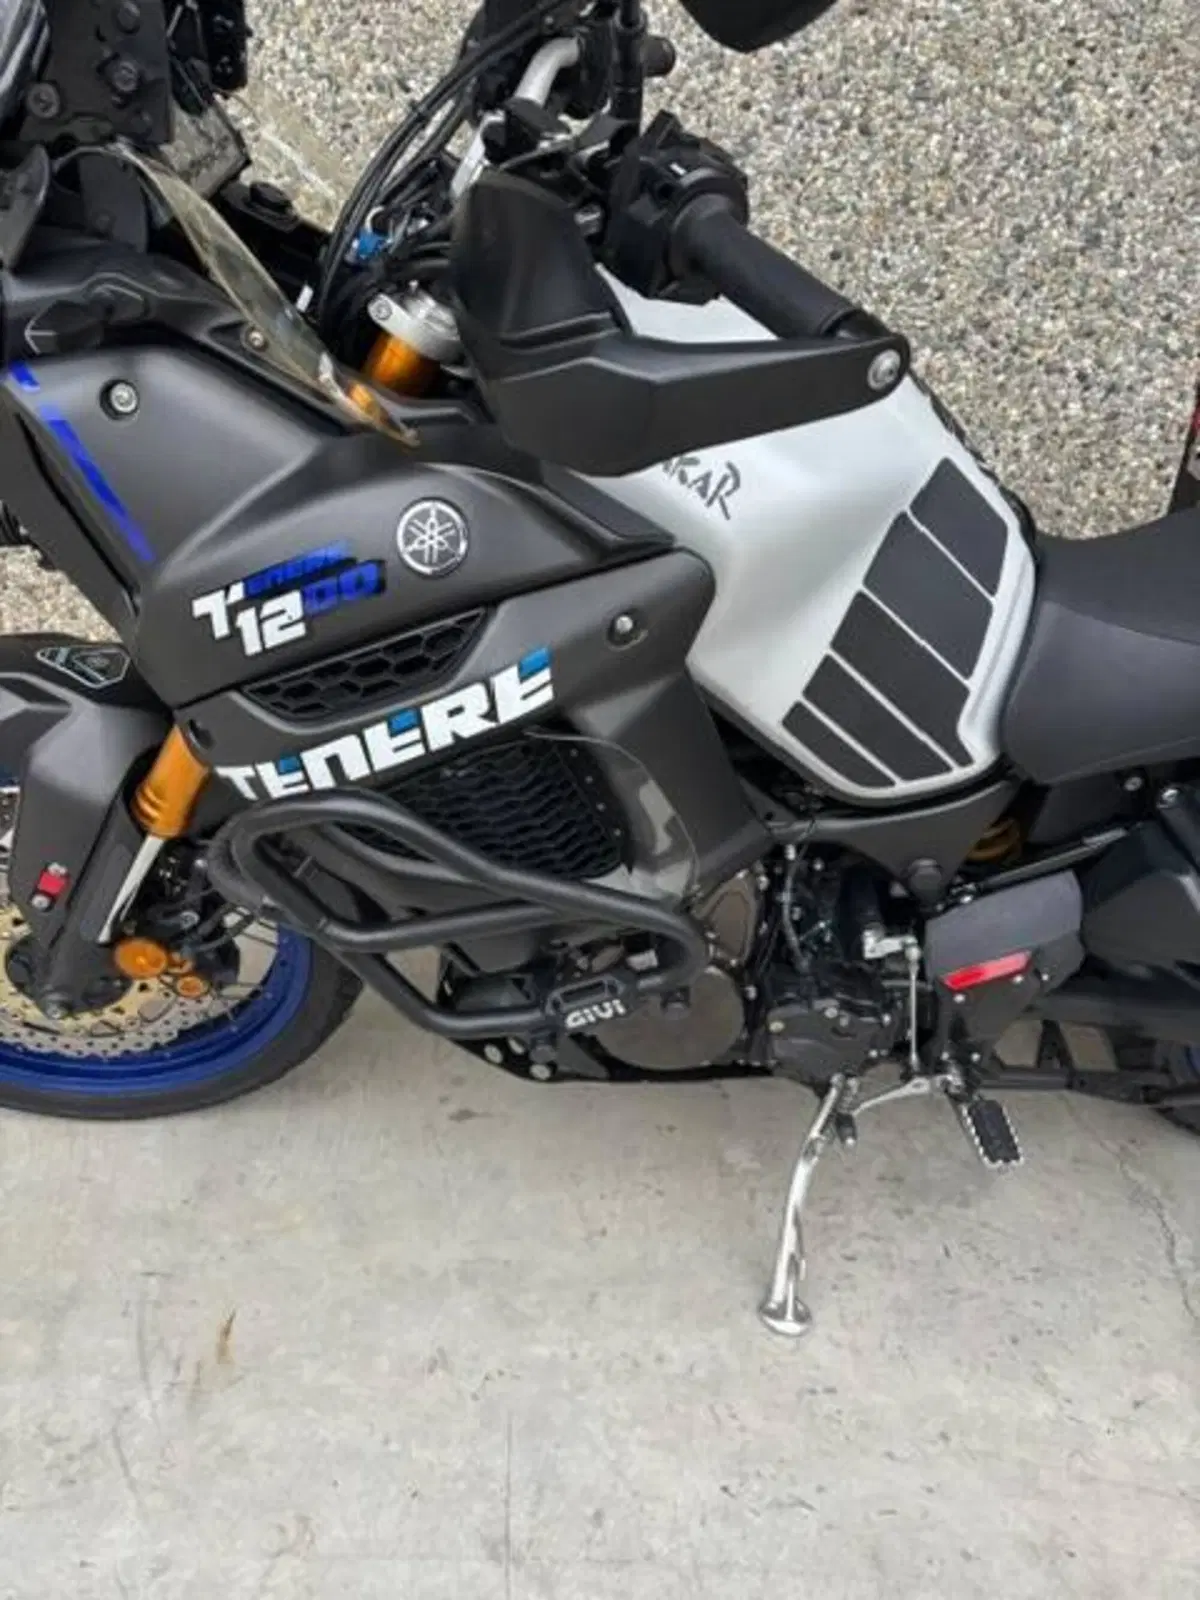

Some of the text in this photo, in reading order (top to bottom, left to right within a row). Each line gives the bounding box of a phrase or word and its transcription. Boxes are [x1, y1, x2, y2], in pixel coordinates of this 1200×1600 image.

[235, 562, 383, 657] 1200
[214, 645, 555, 801] TENERE
[565, 999, 626, 1029] GIVI
